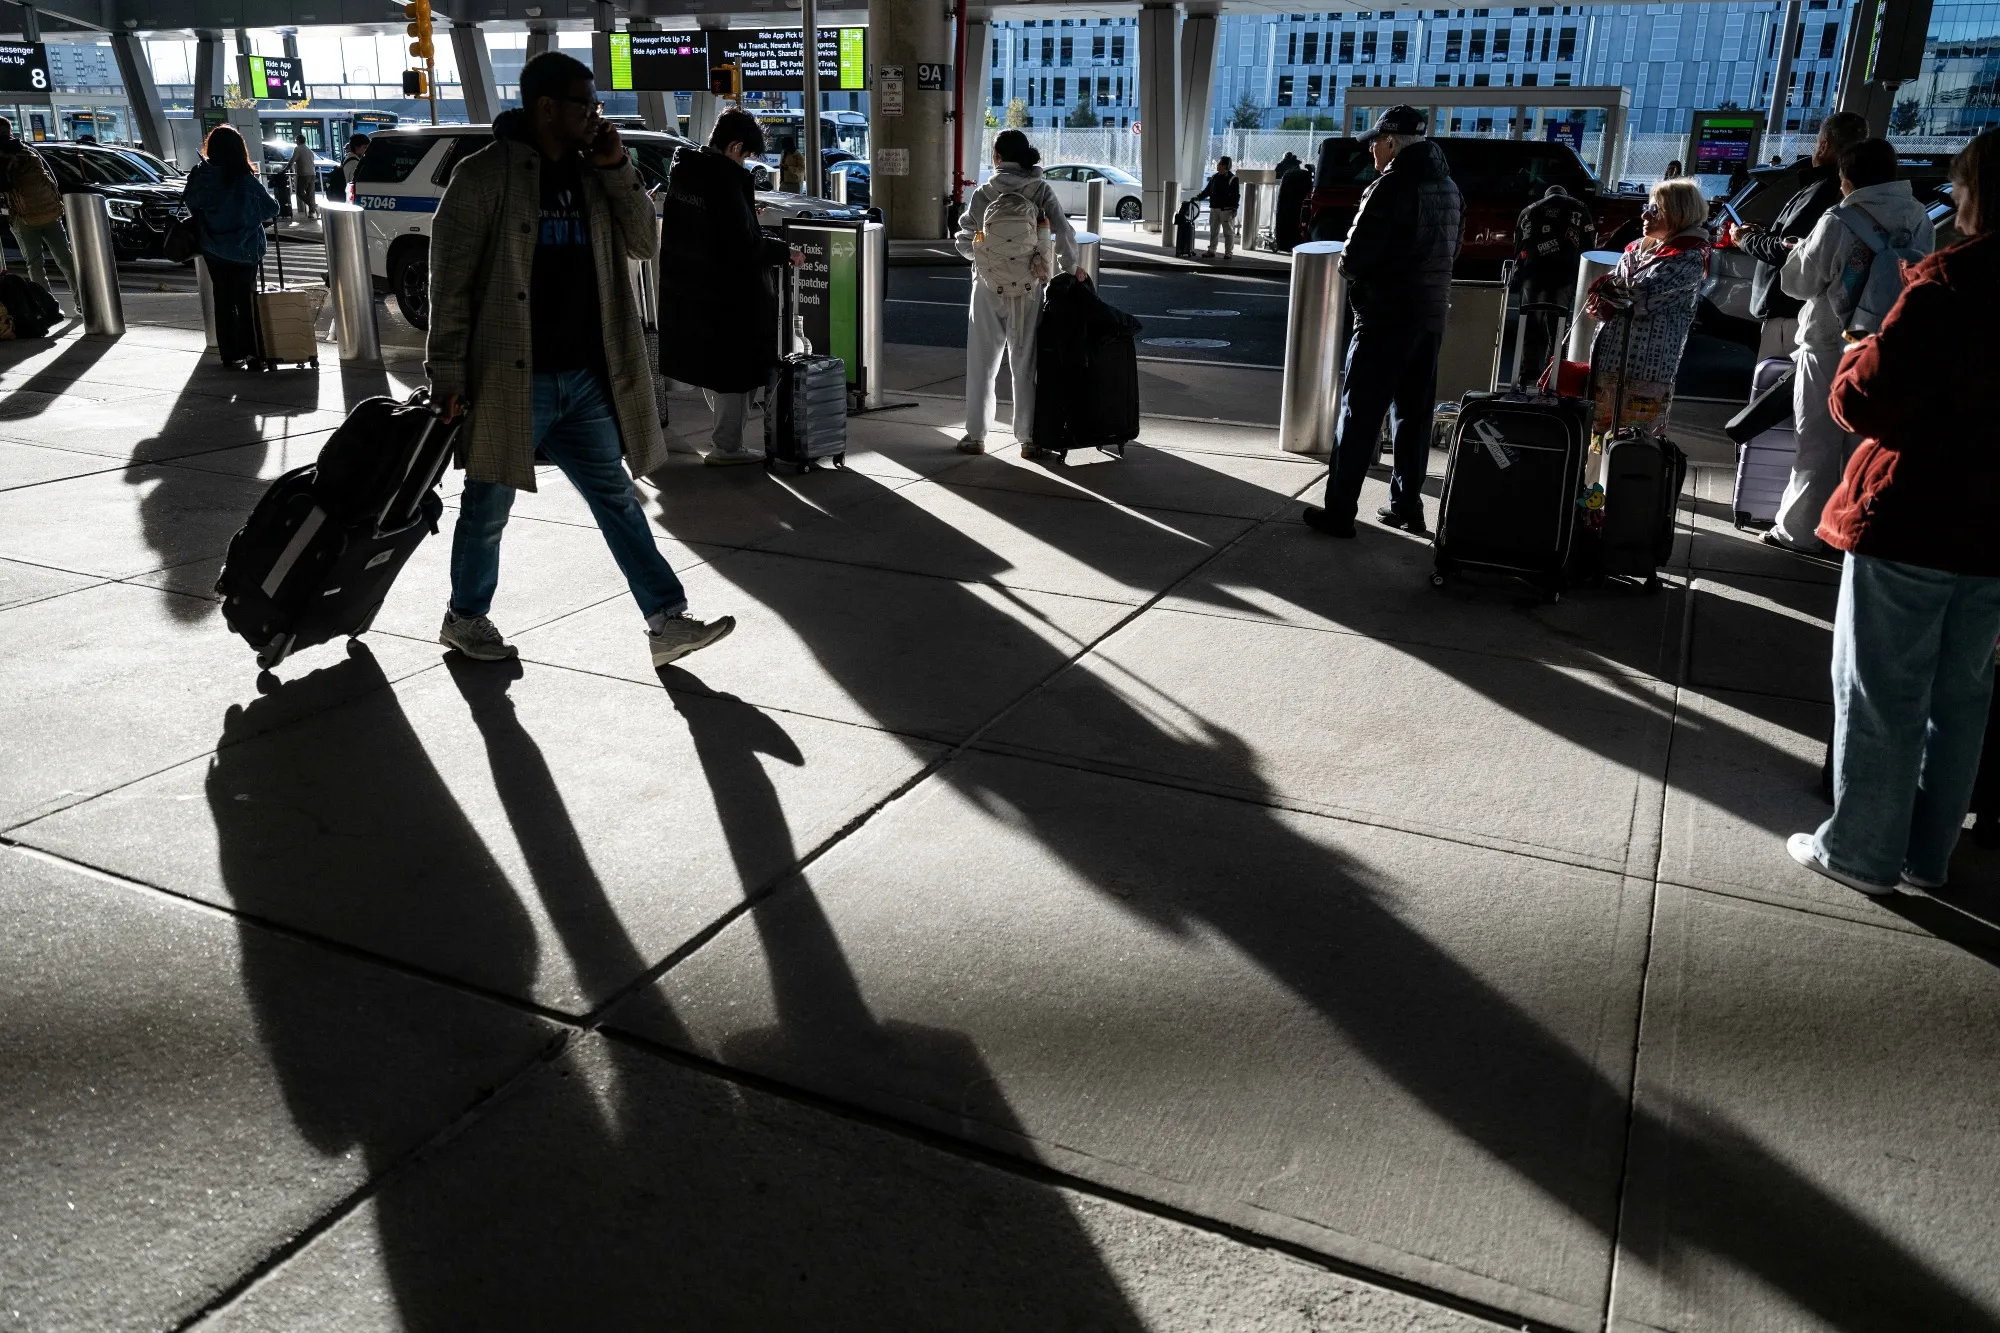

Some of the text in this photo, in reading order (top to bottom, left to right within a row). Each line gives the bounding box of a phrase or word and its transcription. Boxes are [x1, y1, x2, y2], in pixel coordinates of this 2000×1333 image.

[632, 36, 660, 45] Passenger
[0, 46, 34, 55] assenger
[14, 56, 25, 65] Up
[32, 68, 46, 88] 8
[280, 70, 289, 78] Up
[919, 65, 941, 81] 9A
[284, 80, 302, 97] 14
[212, 97, 223, 106] 14
[360, 196, 396, 209] 57046
[803, 244, 823, 255] Taxis:
[1537, 238, 1559, 251] GUESS
[814, 261, 828, 272] See
[791, 276, 828, 289] Dspatcher
[800, 292, 820, 305] Booth
